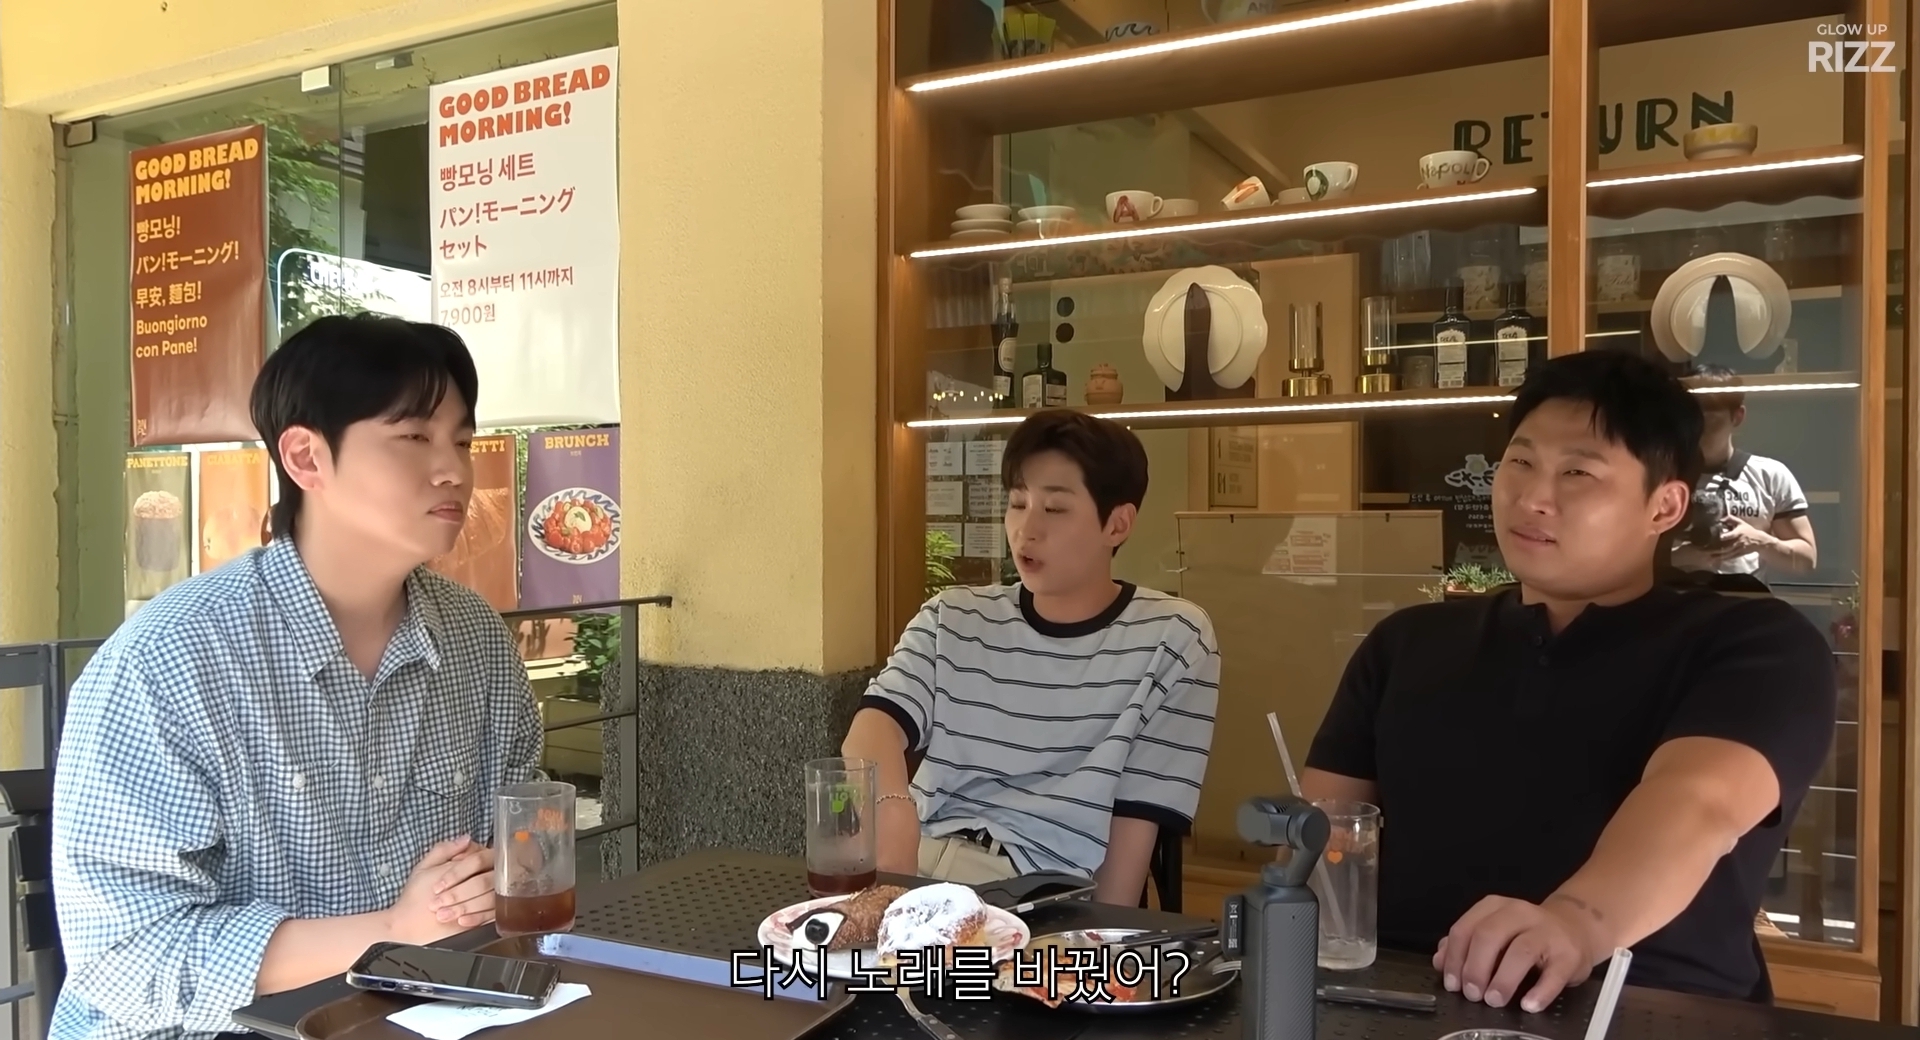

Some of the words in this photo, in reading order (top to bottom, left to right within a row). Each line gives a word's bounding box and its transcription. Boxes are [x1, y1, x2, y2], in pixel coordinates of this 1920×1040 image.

[439, 86, 509, 119] GOOD
[514, 64, 611, 105] BREAD
[439, 101, 572, 148] MORNING!
[1453, 90, 1734, 165] REURN
[135, 153, 187, 181] GOOD
[189, 138, 259, 171] BREAD
[440, 158, 493, 192] 빵모닝
[498, 152, 536, 181] 세트
[135, 168, 231, 205] MORNING!
[136, 214, 181, 241] 빵모닝!
[439, 234, 487, 260] セット
[440, 279, 464, 298] 오전
[467, 273, 515, 296] 8시부터
[519, 266, 574, 290] 11시까지
[136, 314, 208, 335] Buongiorno
[135, 345, 159, 358] con
[162, 337, 197, 355] Pane!
[544, 433, 610, 450] BRUNCH
[126, 456, 188, 468] PANETTONE
